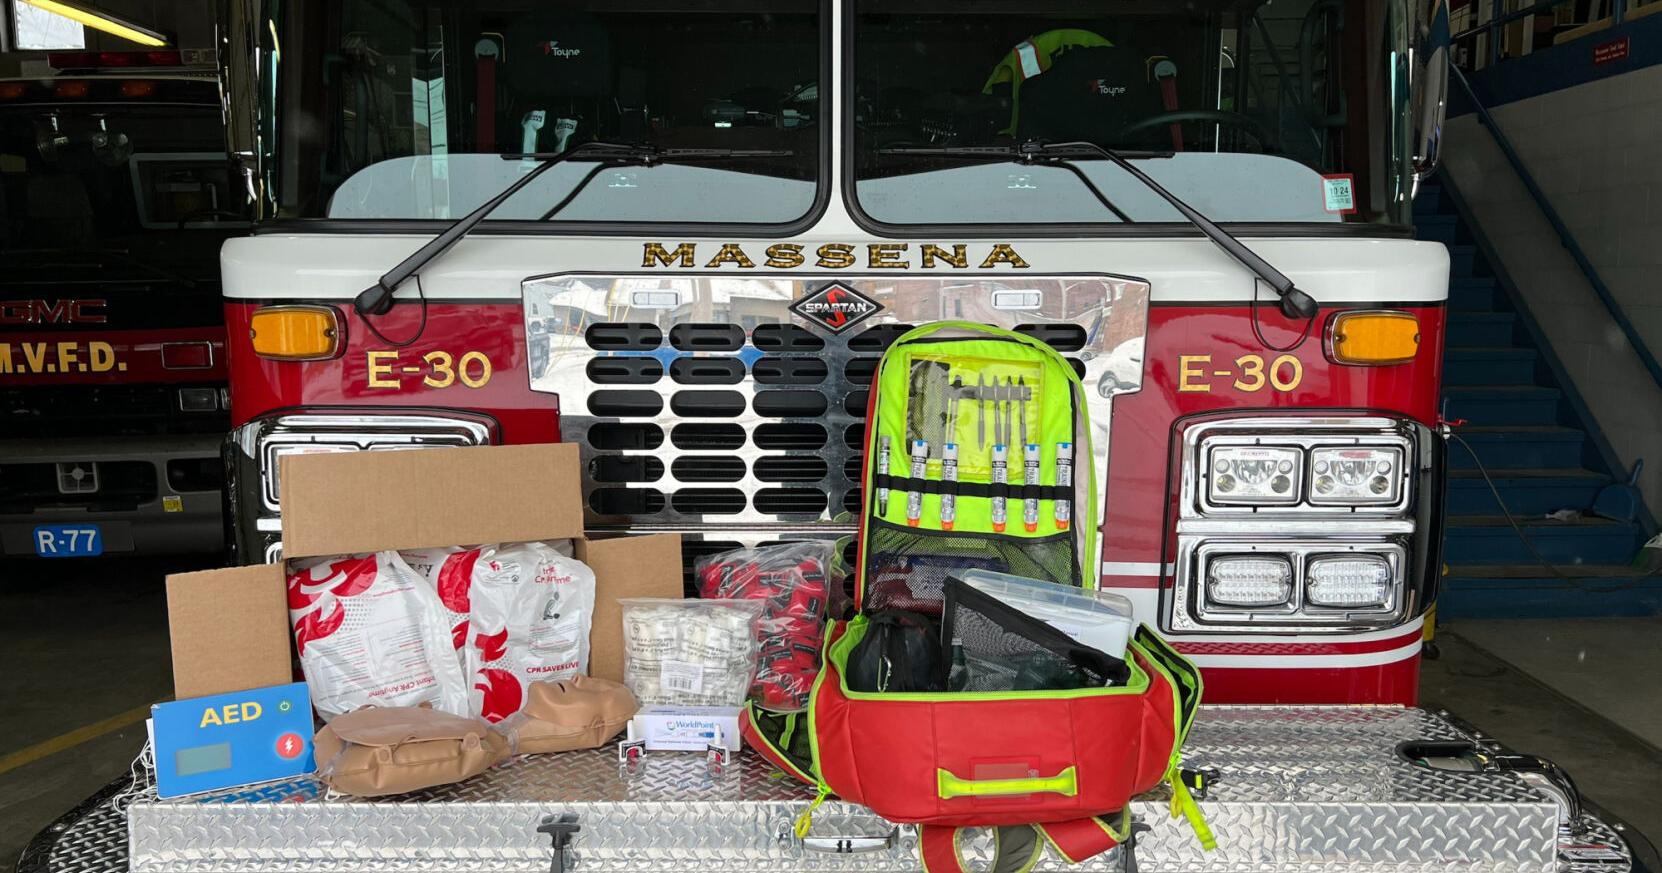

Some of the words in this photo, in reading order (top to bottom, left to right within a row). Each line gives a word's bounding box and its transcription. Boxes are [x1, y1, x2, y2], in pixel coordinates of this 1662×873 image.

[551, 47, 581, 59] Toyne
[1098, 85, 1126, 97] Toyne
[641, 242, 1031, 269] MASSENA
[0, 299, 107, 324] GMC
[805, 302, 868, 313] SPARTAN
[366, 350, 493, 390] E-30
[1177, 354, 1304, 393] E-30
[38, 529, 97, 553] R-77
[200, 701, 263, 728] AED
[675, 719, 714, 729] WorldPoint
